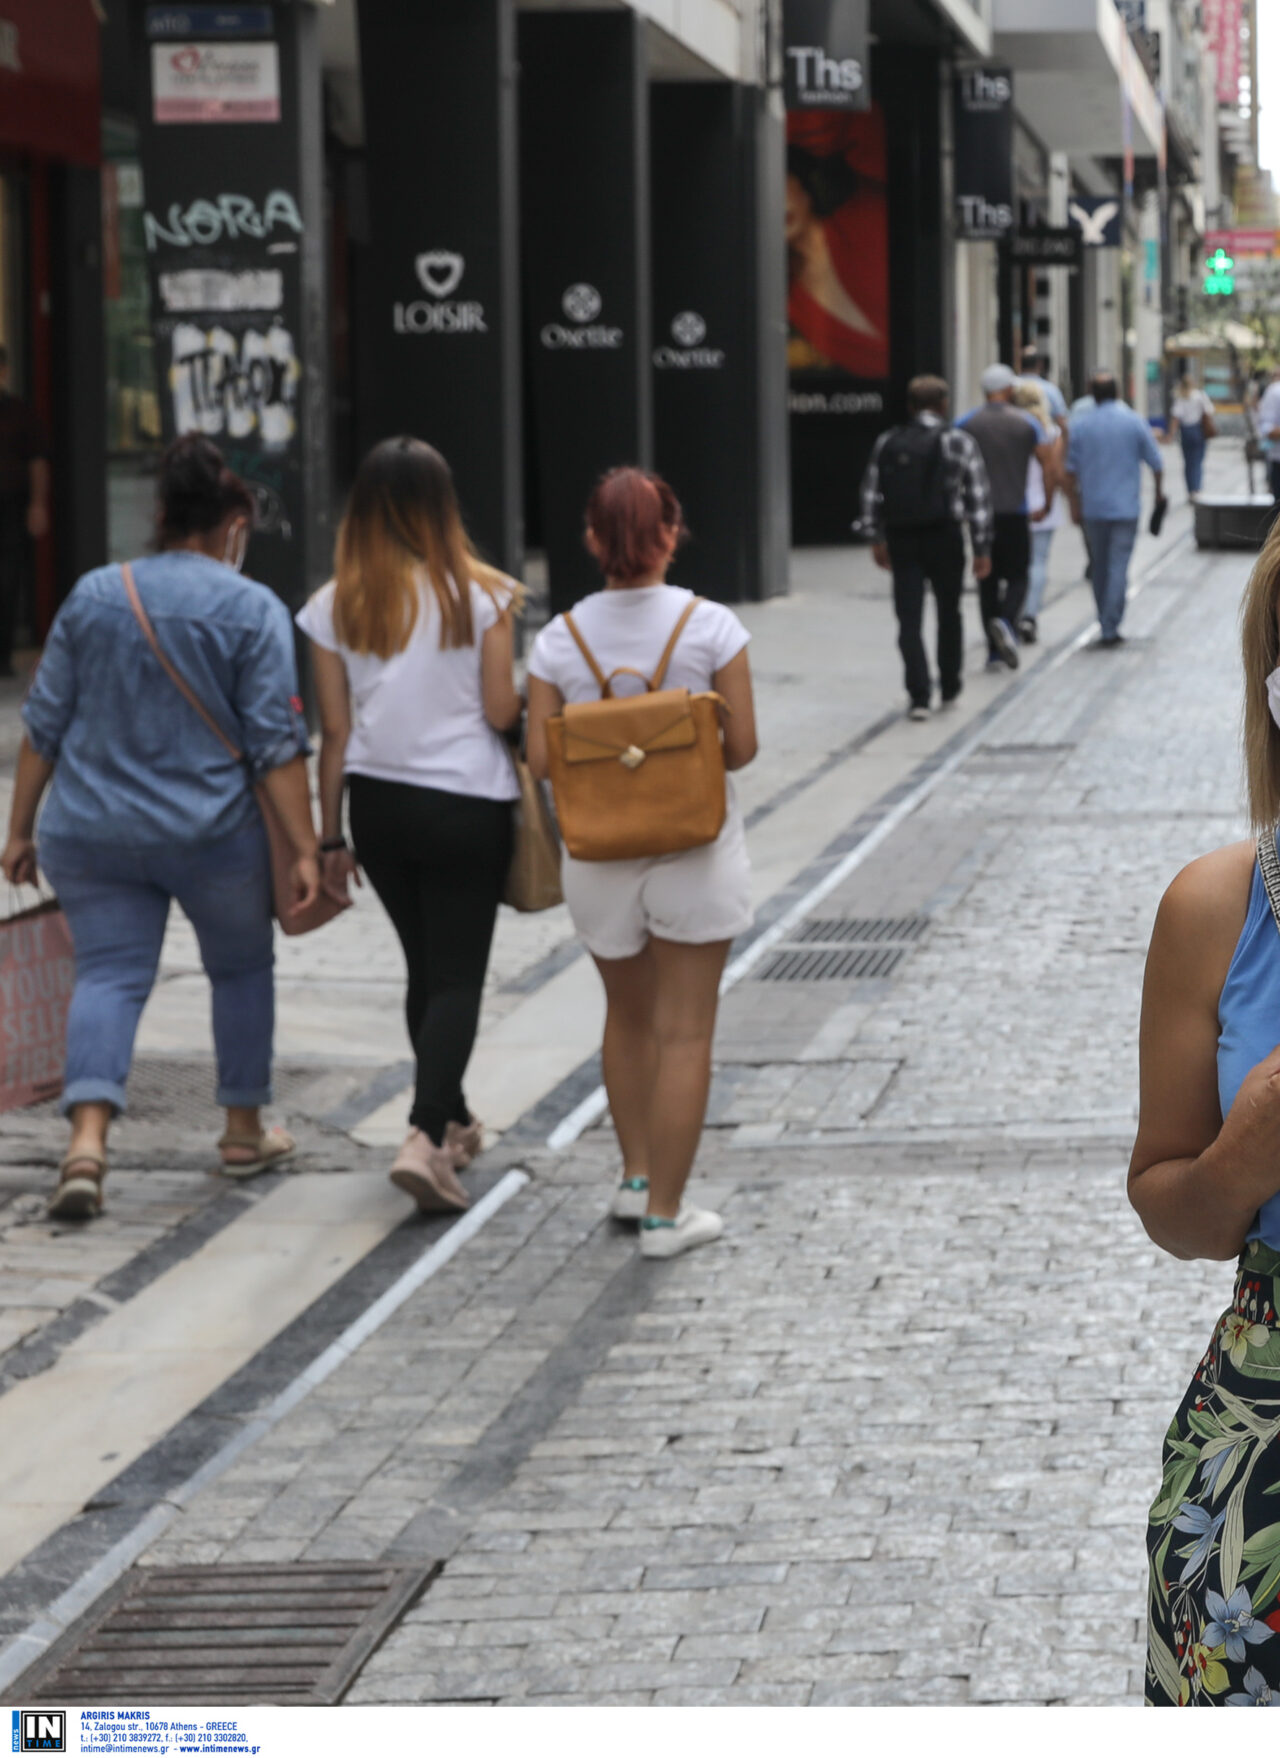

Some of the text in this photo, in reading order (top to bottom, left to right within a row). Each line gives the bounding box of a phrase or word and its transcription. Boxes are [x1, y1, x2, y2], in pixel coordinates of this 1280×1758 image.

[786, 46, 862, 90] Ths
[143, 189, 304, 253] NORA
[959, 196, 1012, 229] Ths
[393, 301, 488, 334] LOISIR
